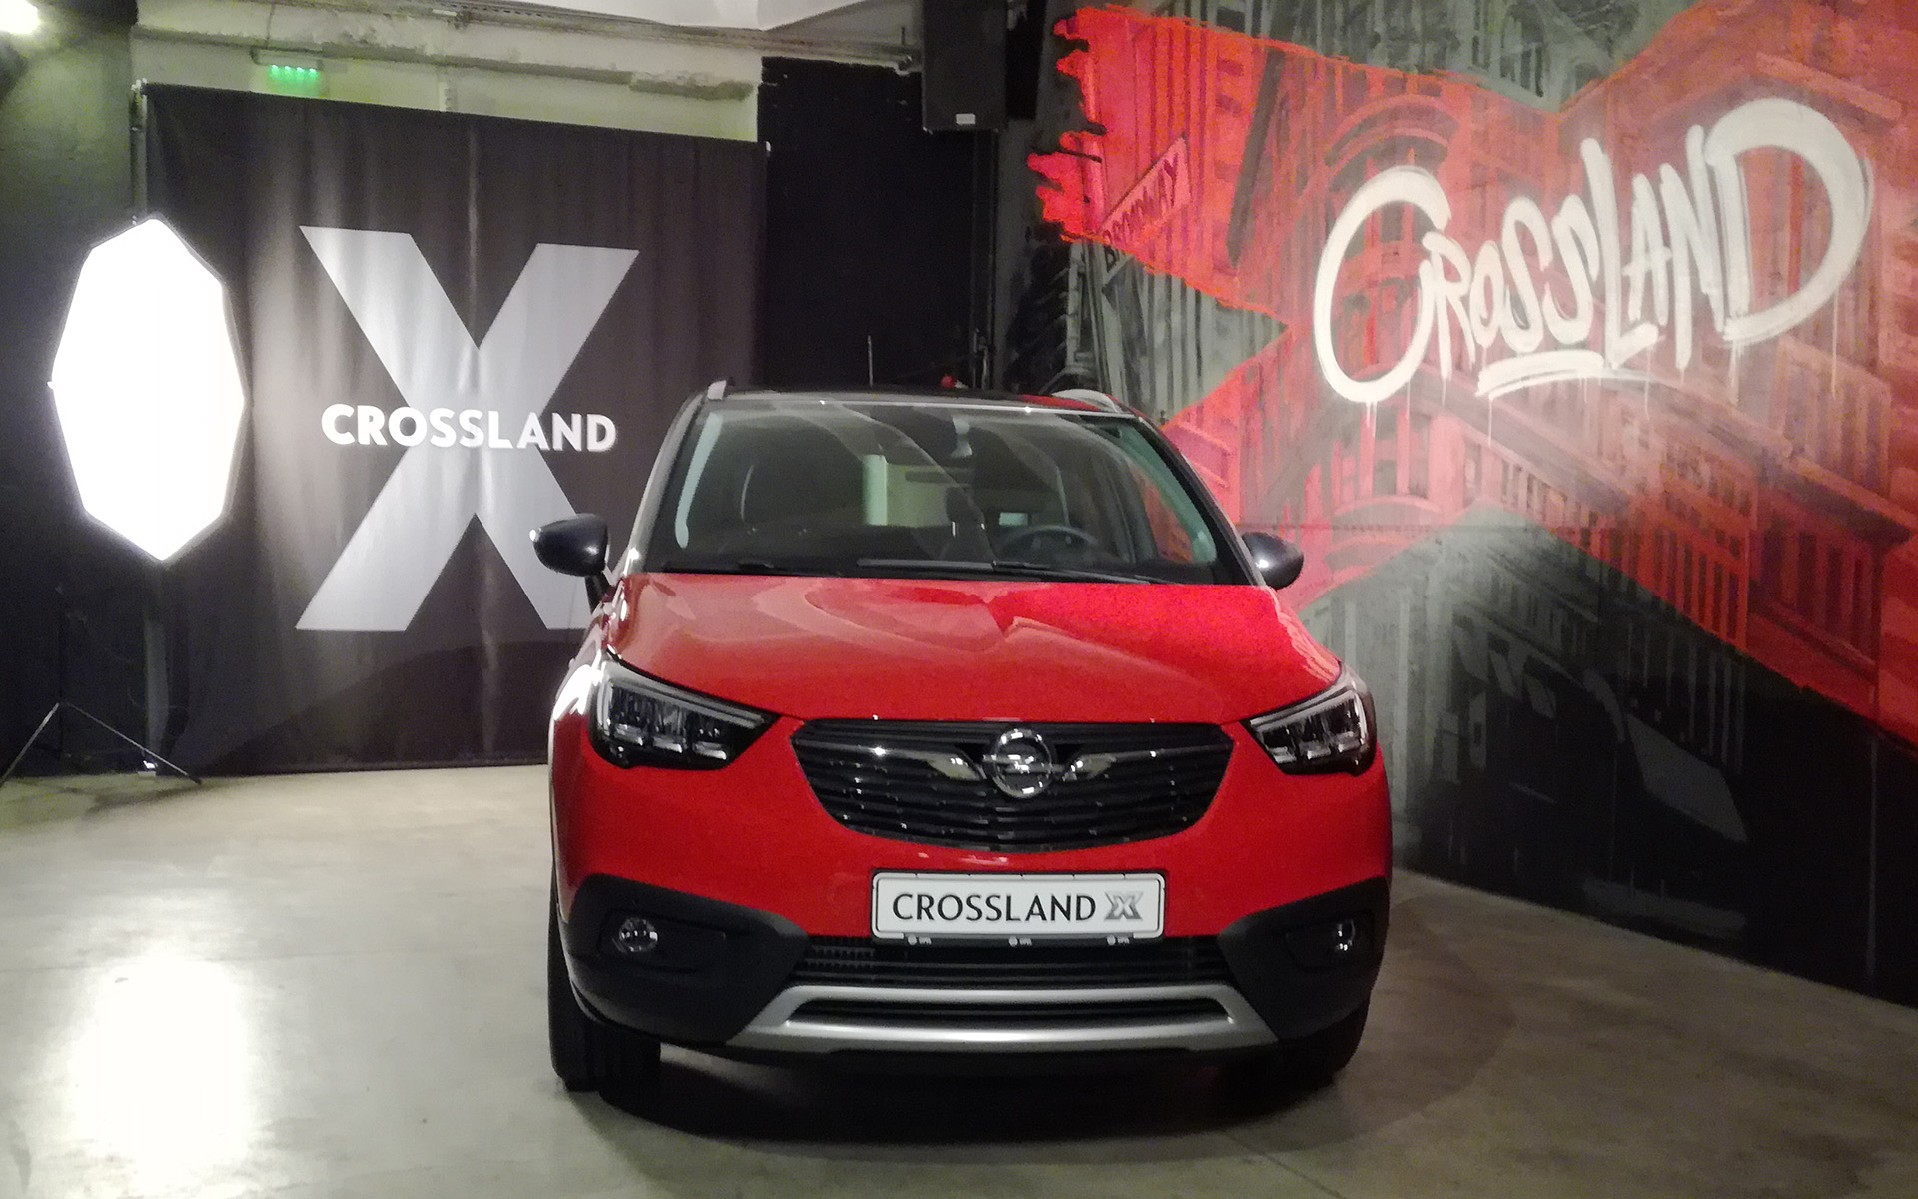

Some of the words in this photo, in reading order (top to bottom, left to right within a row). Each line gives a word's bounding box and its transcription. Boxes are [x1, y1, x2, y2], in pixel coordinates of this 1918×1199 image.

[1313, 98, 1874, 404] CROSSLAND
[296, 225, 640, 632] X
[321, 403, 617, 453] CROSSLAND
[892, 892, 1096, 922] CROSSLAND
[1103, 890, 1145, 921] X
